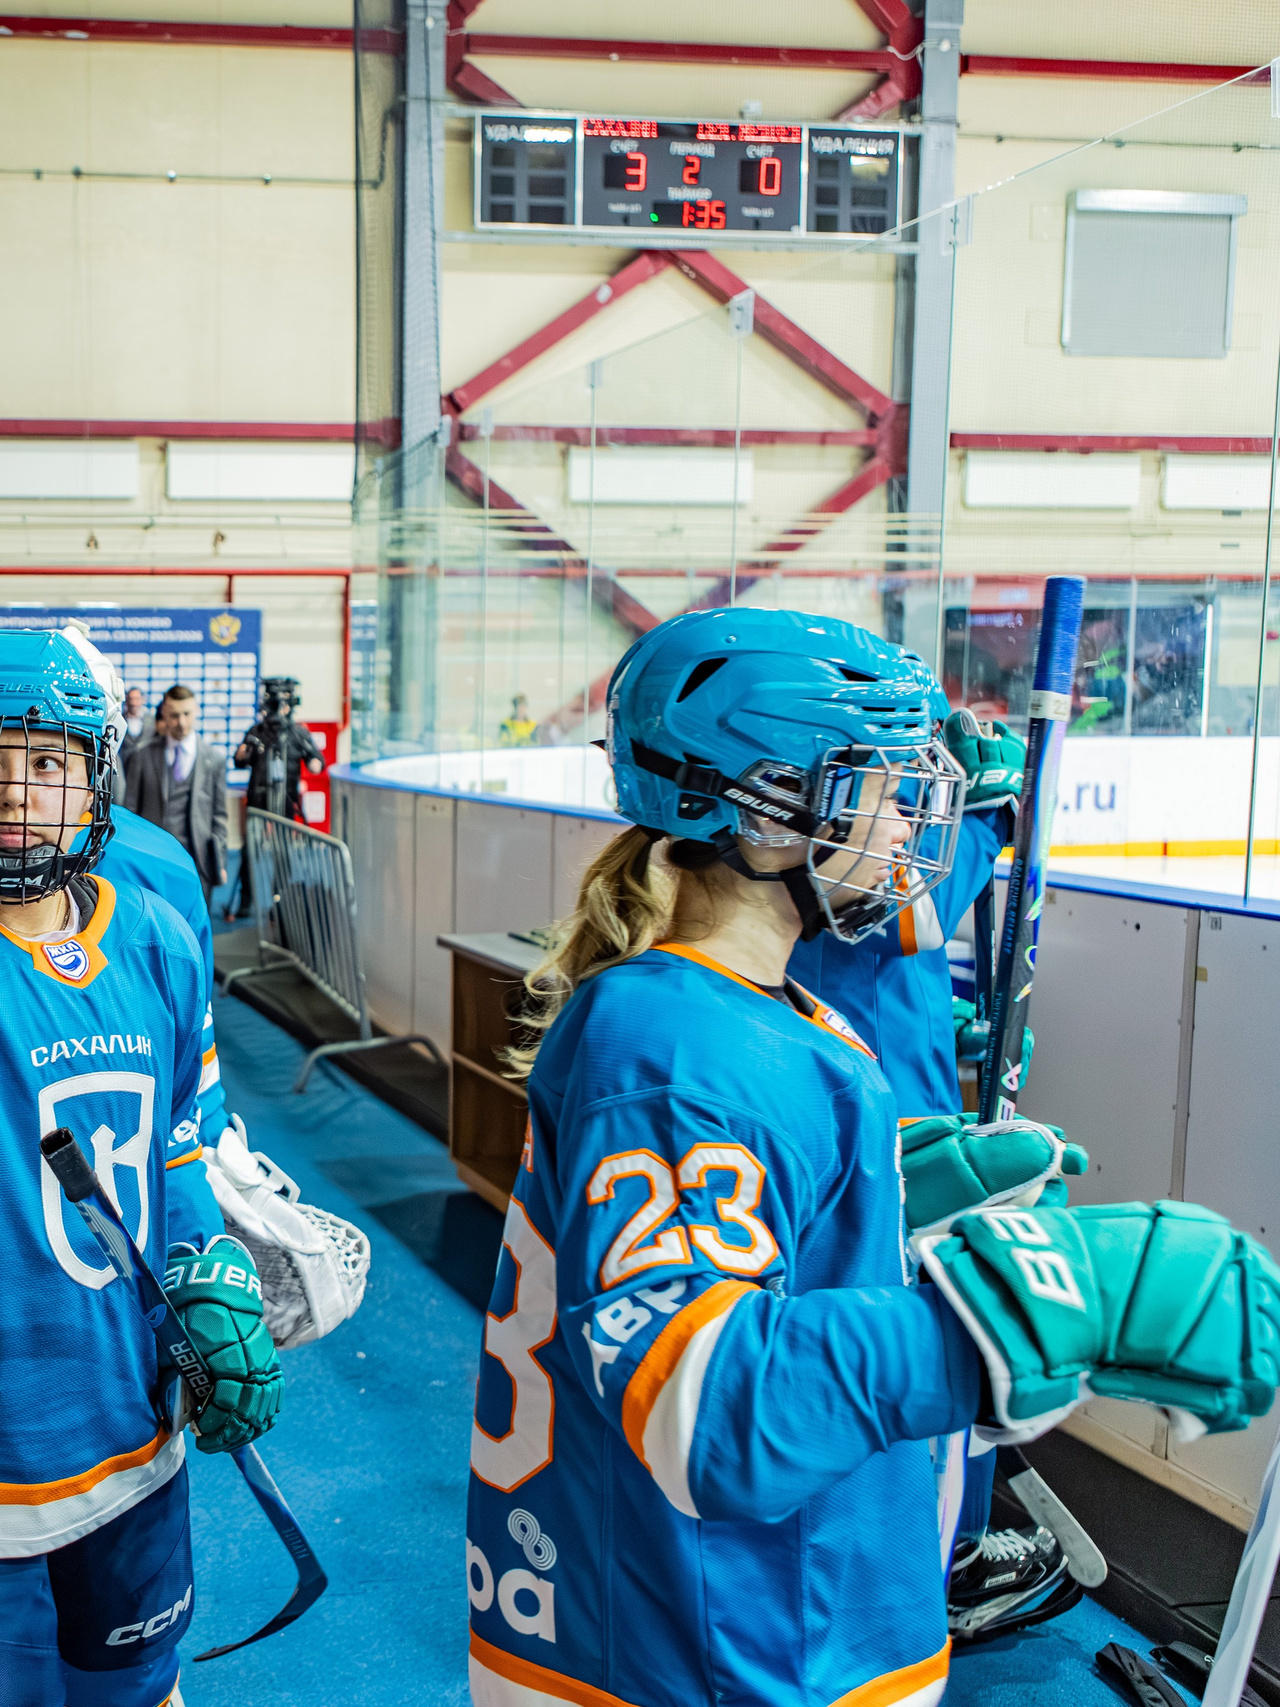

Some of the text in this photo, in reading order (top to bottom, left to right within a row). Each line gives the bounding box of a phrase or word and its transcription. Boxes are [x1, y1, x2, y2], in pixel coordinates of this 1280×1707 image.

[624, 152, 647, 191] 3
[682, 155, 700, 184] 2
[758, 157, 781, 196] 0
[682, 199, 726, 230] 1:35
[722, 787, 796, 821] BAUER
[46, 941, 80, 958] ЖХЛ
[30, 1034, 152, 1067] САХАЛИН
[585, 1142, 779, 1291] 23
[162, 1261, 264, 1301] AUER
[169, 1340, 215, 1398] BAUER
[105, 1584, 193, 1646] CCM
